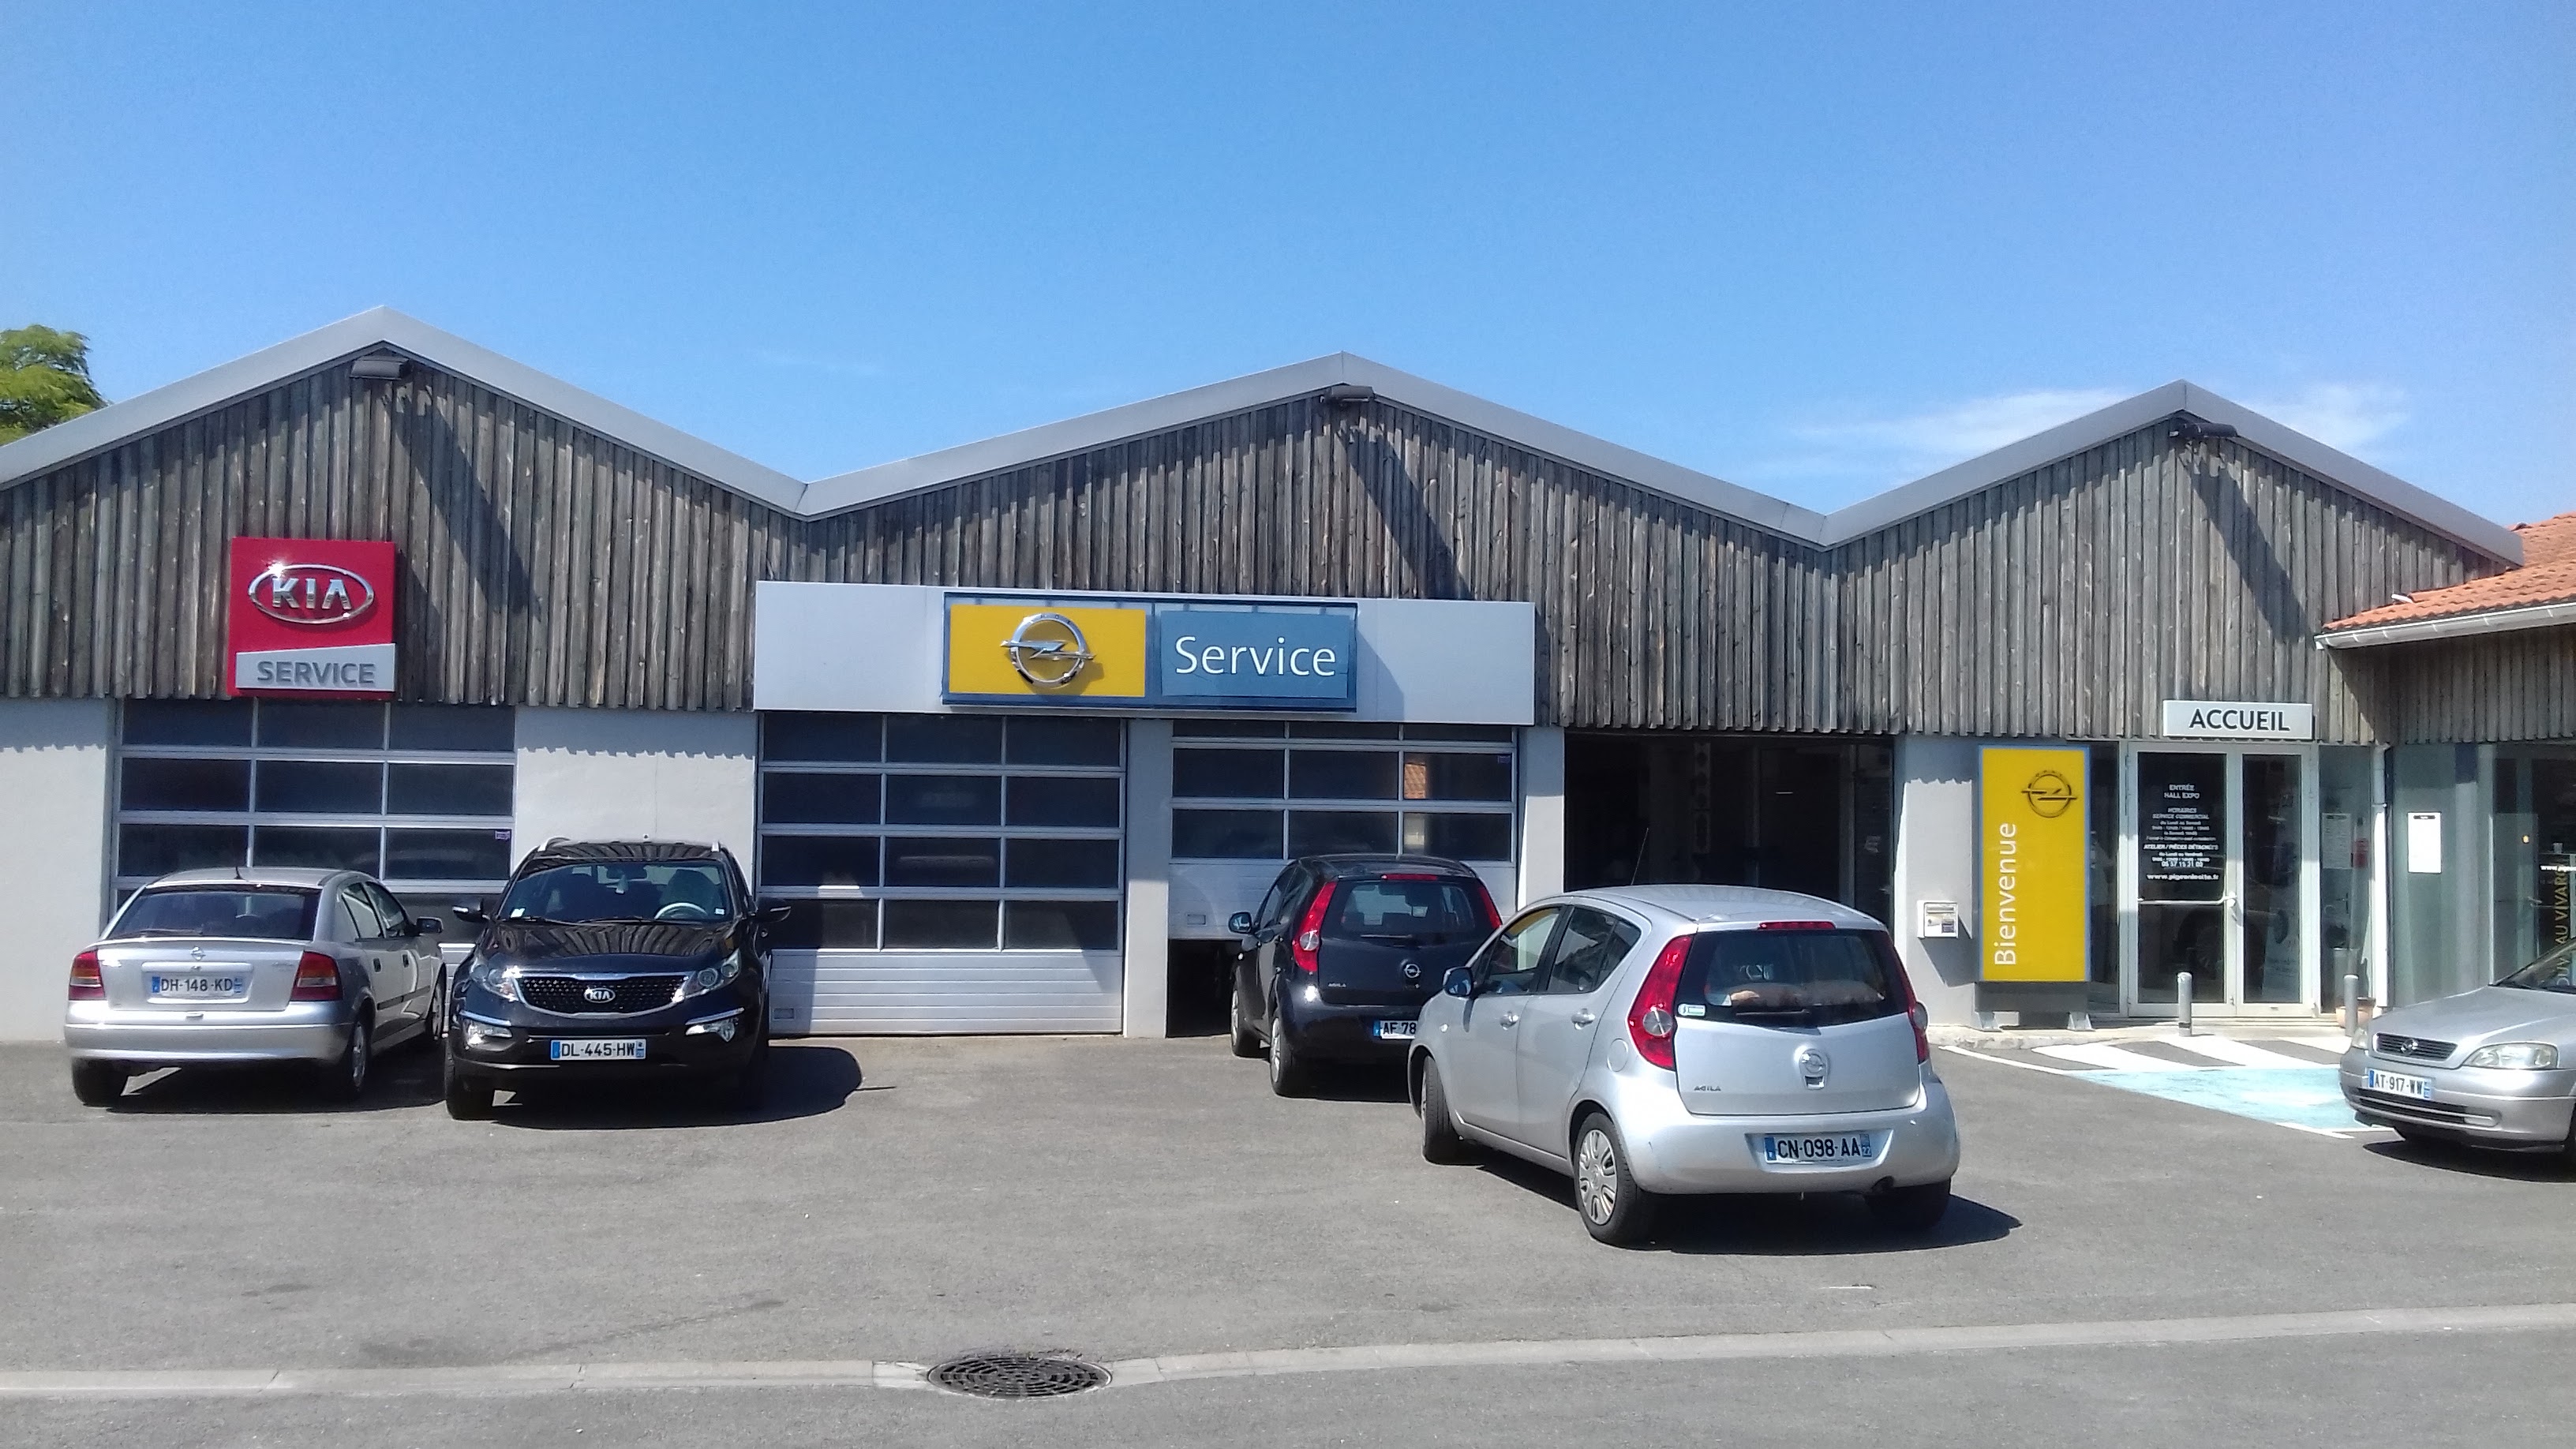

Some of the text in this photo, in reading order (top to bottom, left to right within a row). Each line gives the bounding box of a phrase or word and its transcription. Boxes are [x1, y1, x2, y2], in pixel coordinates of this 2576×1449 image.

[271, 577, 353, 610] KIA
[1175, 635, 1336, 677] Service
[256, 661, 376, 684] SERVICE
[2188, 708, 2291, 732] ACCUEIL
[1993, 822, 2016, 965] Bienvenue
[161, 978, 234, 992] DH-148-KD
[590, 990, 611, 1001] KIA
[561, 1042, 635, 1057] DL-445-HW
[1777, 1137, 1861, 1159] CN-098-AA
